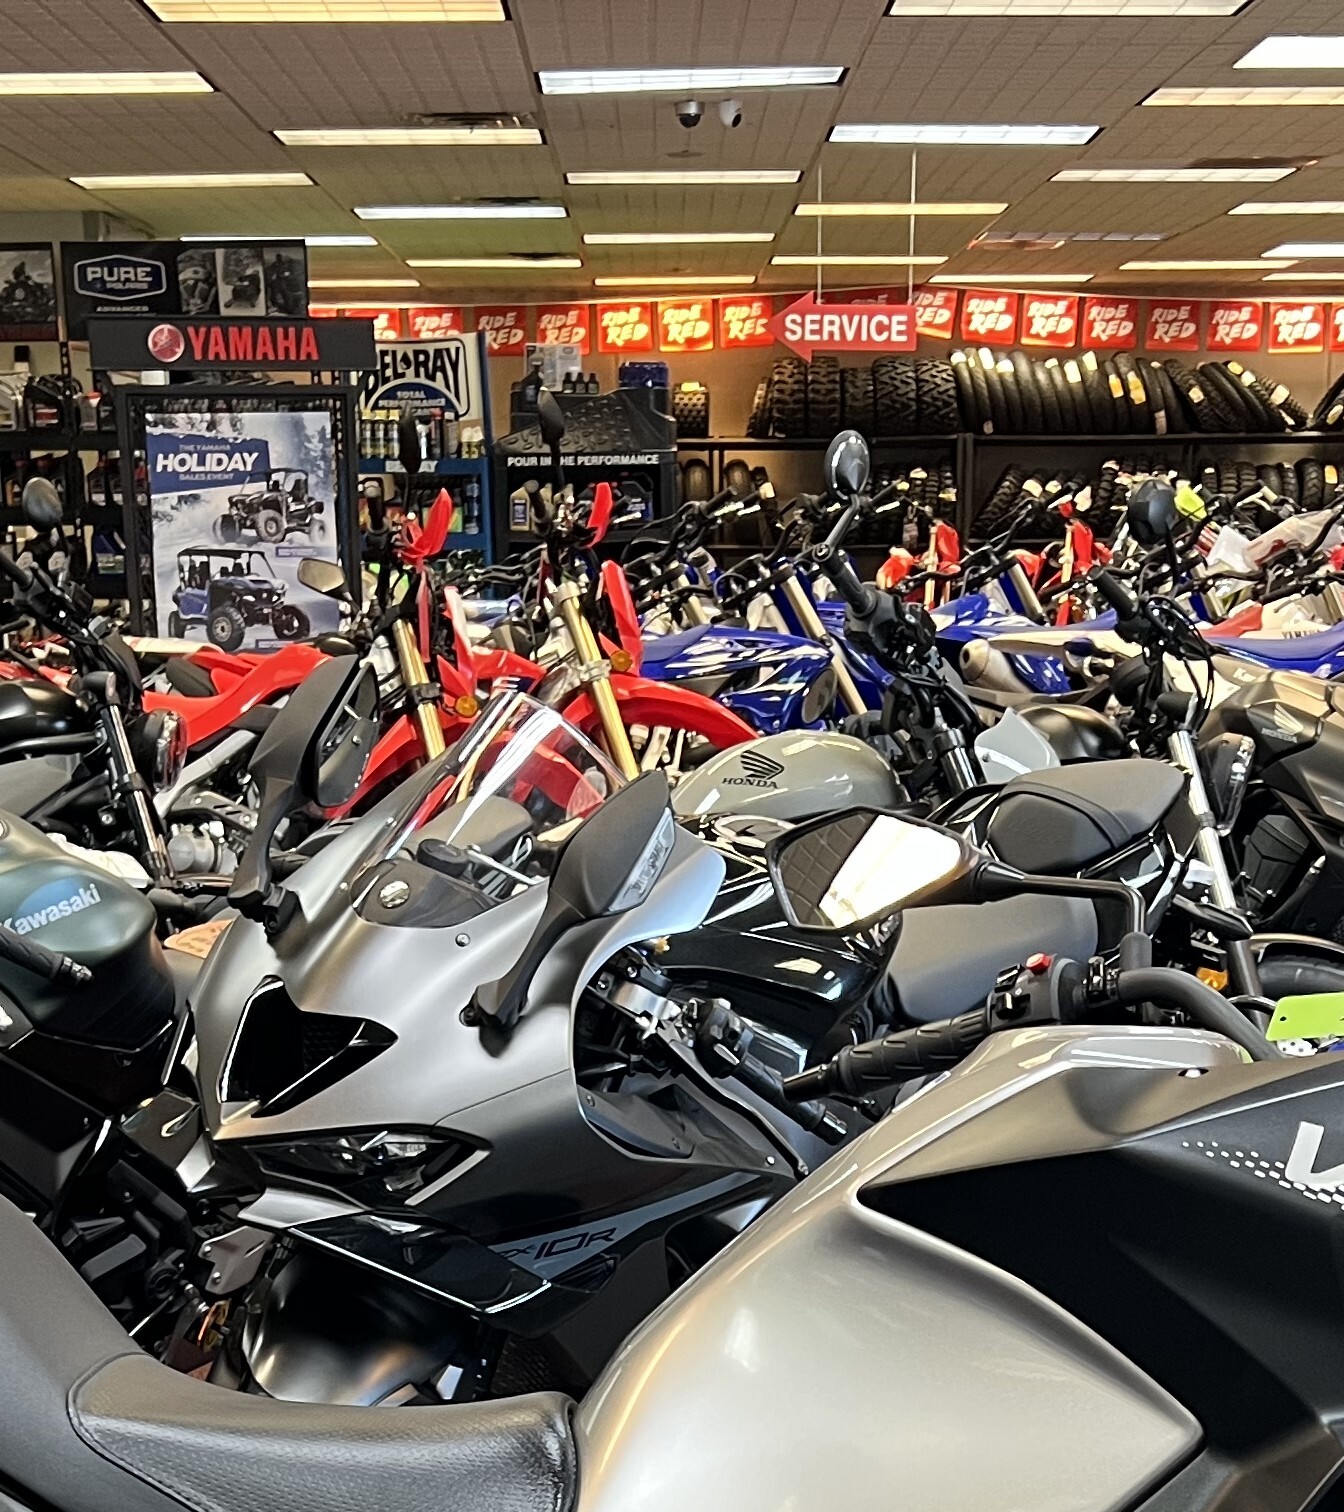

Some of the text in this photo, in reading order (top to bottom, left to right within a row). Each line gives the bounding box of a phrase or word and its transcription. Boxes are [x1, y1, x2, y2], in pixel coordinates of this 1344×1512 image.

[86, 266, 152, 282] PURE
[662, 304, 702, 325] RIDE
[723, 302, 763, 321] RIDE
[967, 297, 1008, 314] RIDE
[1027, 300, 1069, 318] RIDE
[1088, 304, 1129, 321] RIDE
[1151, 305, 1191, 322] RIDE
[1212, 306, 1253, 324] RIDE
[414, 313, 453, 331] RIDE
[477, 312, 517, 330] RIDE
[539, 310, 579, 329] RIDE
[602, 306, 641, 327] RIDE
[968, 313, 1013, 335] RED
[1273, 306, 1315, 325] RIDE
[545, 327, 586, 345] RED
[606, 323, 648, 346] RED
[667, 321, 710, 343] RED
[784, 313, 908, 342] SERVICE
[1030, 316, 1074, 338] RED
[1090, 320, 1134, 342] RED
[1153, 321, 1196, 343] RED
[1214, 322, 1258, 345] RED
[1277, 322, 1321, 345] RED
[186, 325, 320, 362] YAMAHA
[487, 328, 524, 350] RED
[396, 391, 426, 399] TOTAL
[156, 452, 259, 473] HOLIDAY
[507, 456, 538, 467] POUR
[540, 456, 552, 466] IN
[577, 454, 660, 466] PERFORMANCE
[722, 777, 779, 789] HONDA
